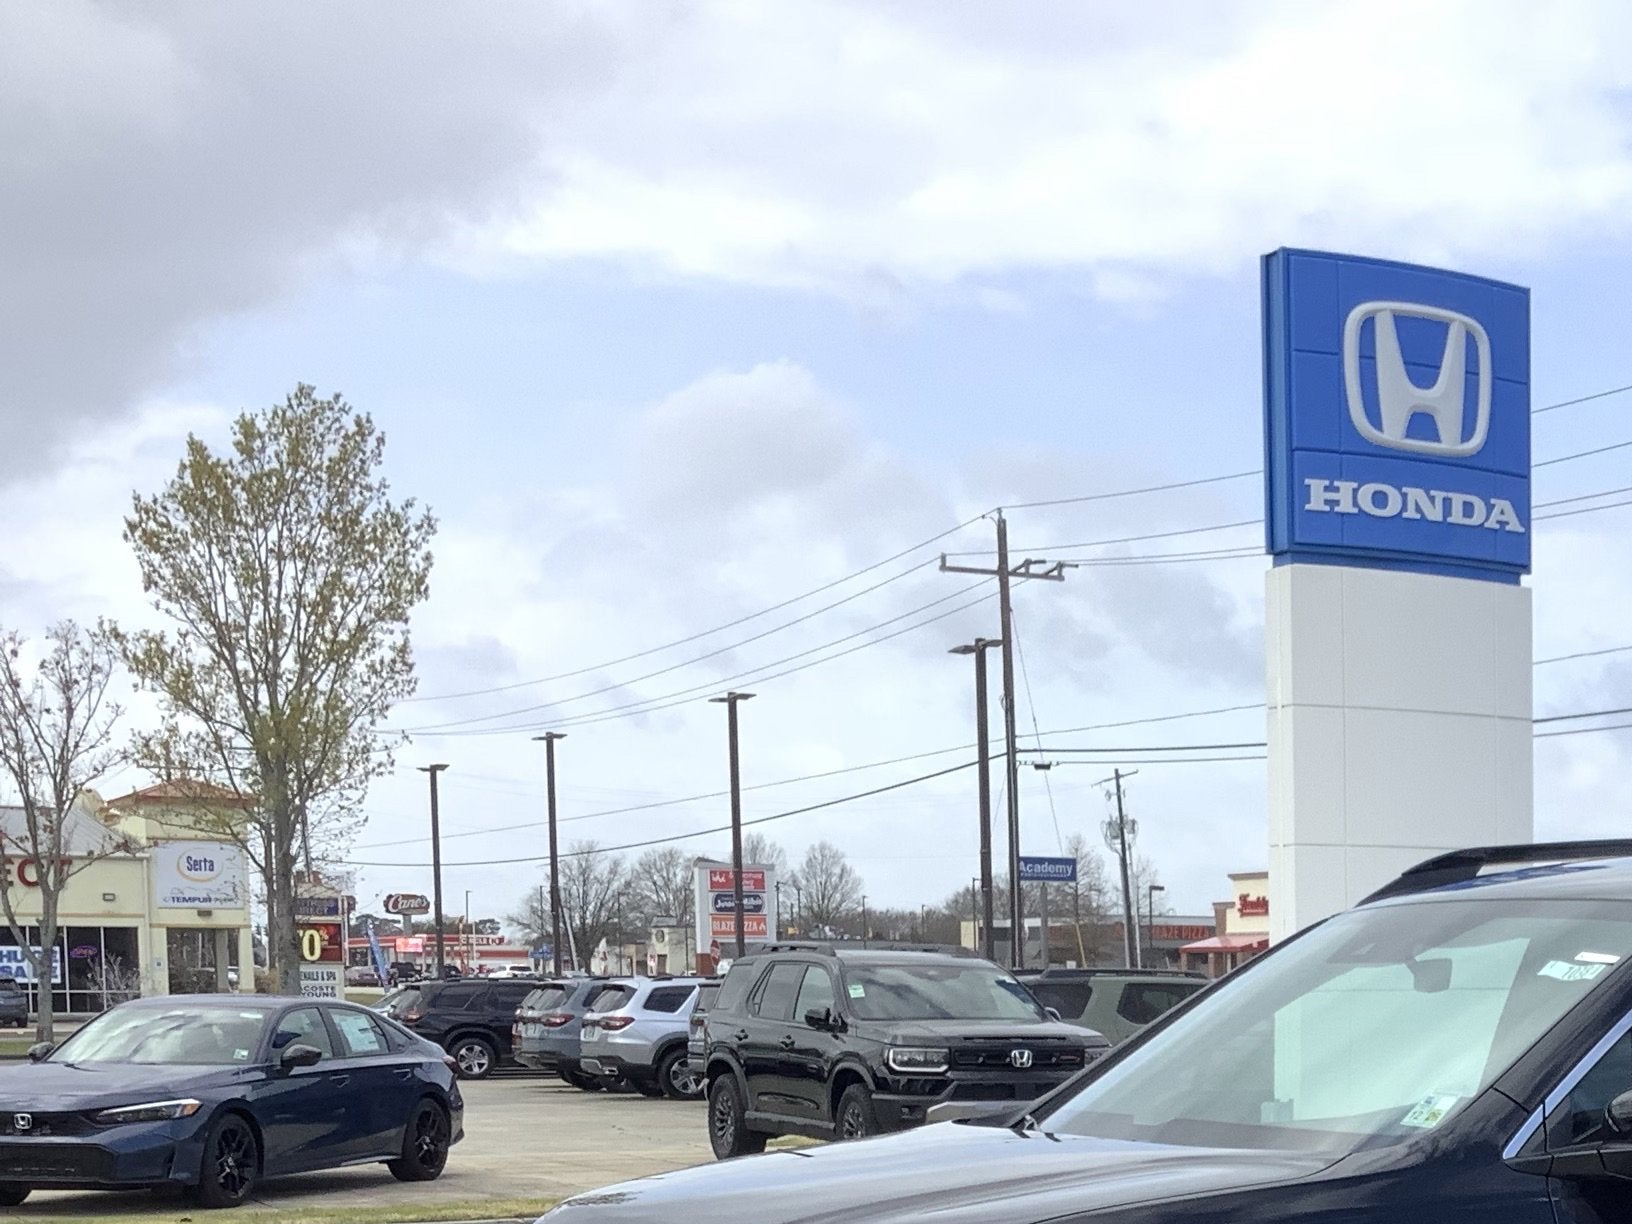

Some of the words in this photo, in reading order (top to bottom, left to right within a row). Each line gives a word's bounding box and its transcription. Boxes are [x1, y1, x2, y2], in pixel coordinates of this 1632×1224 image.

[1304, 478, 1525, 533] HONDA
[186, 856, 215, 872] Serta
[1019, 861, 1073, 876] Academy
